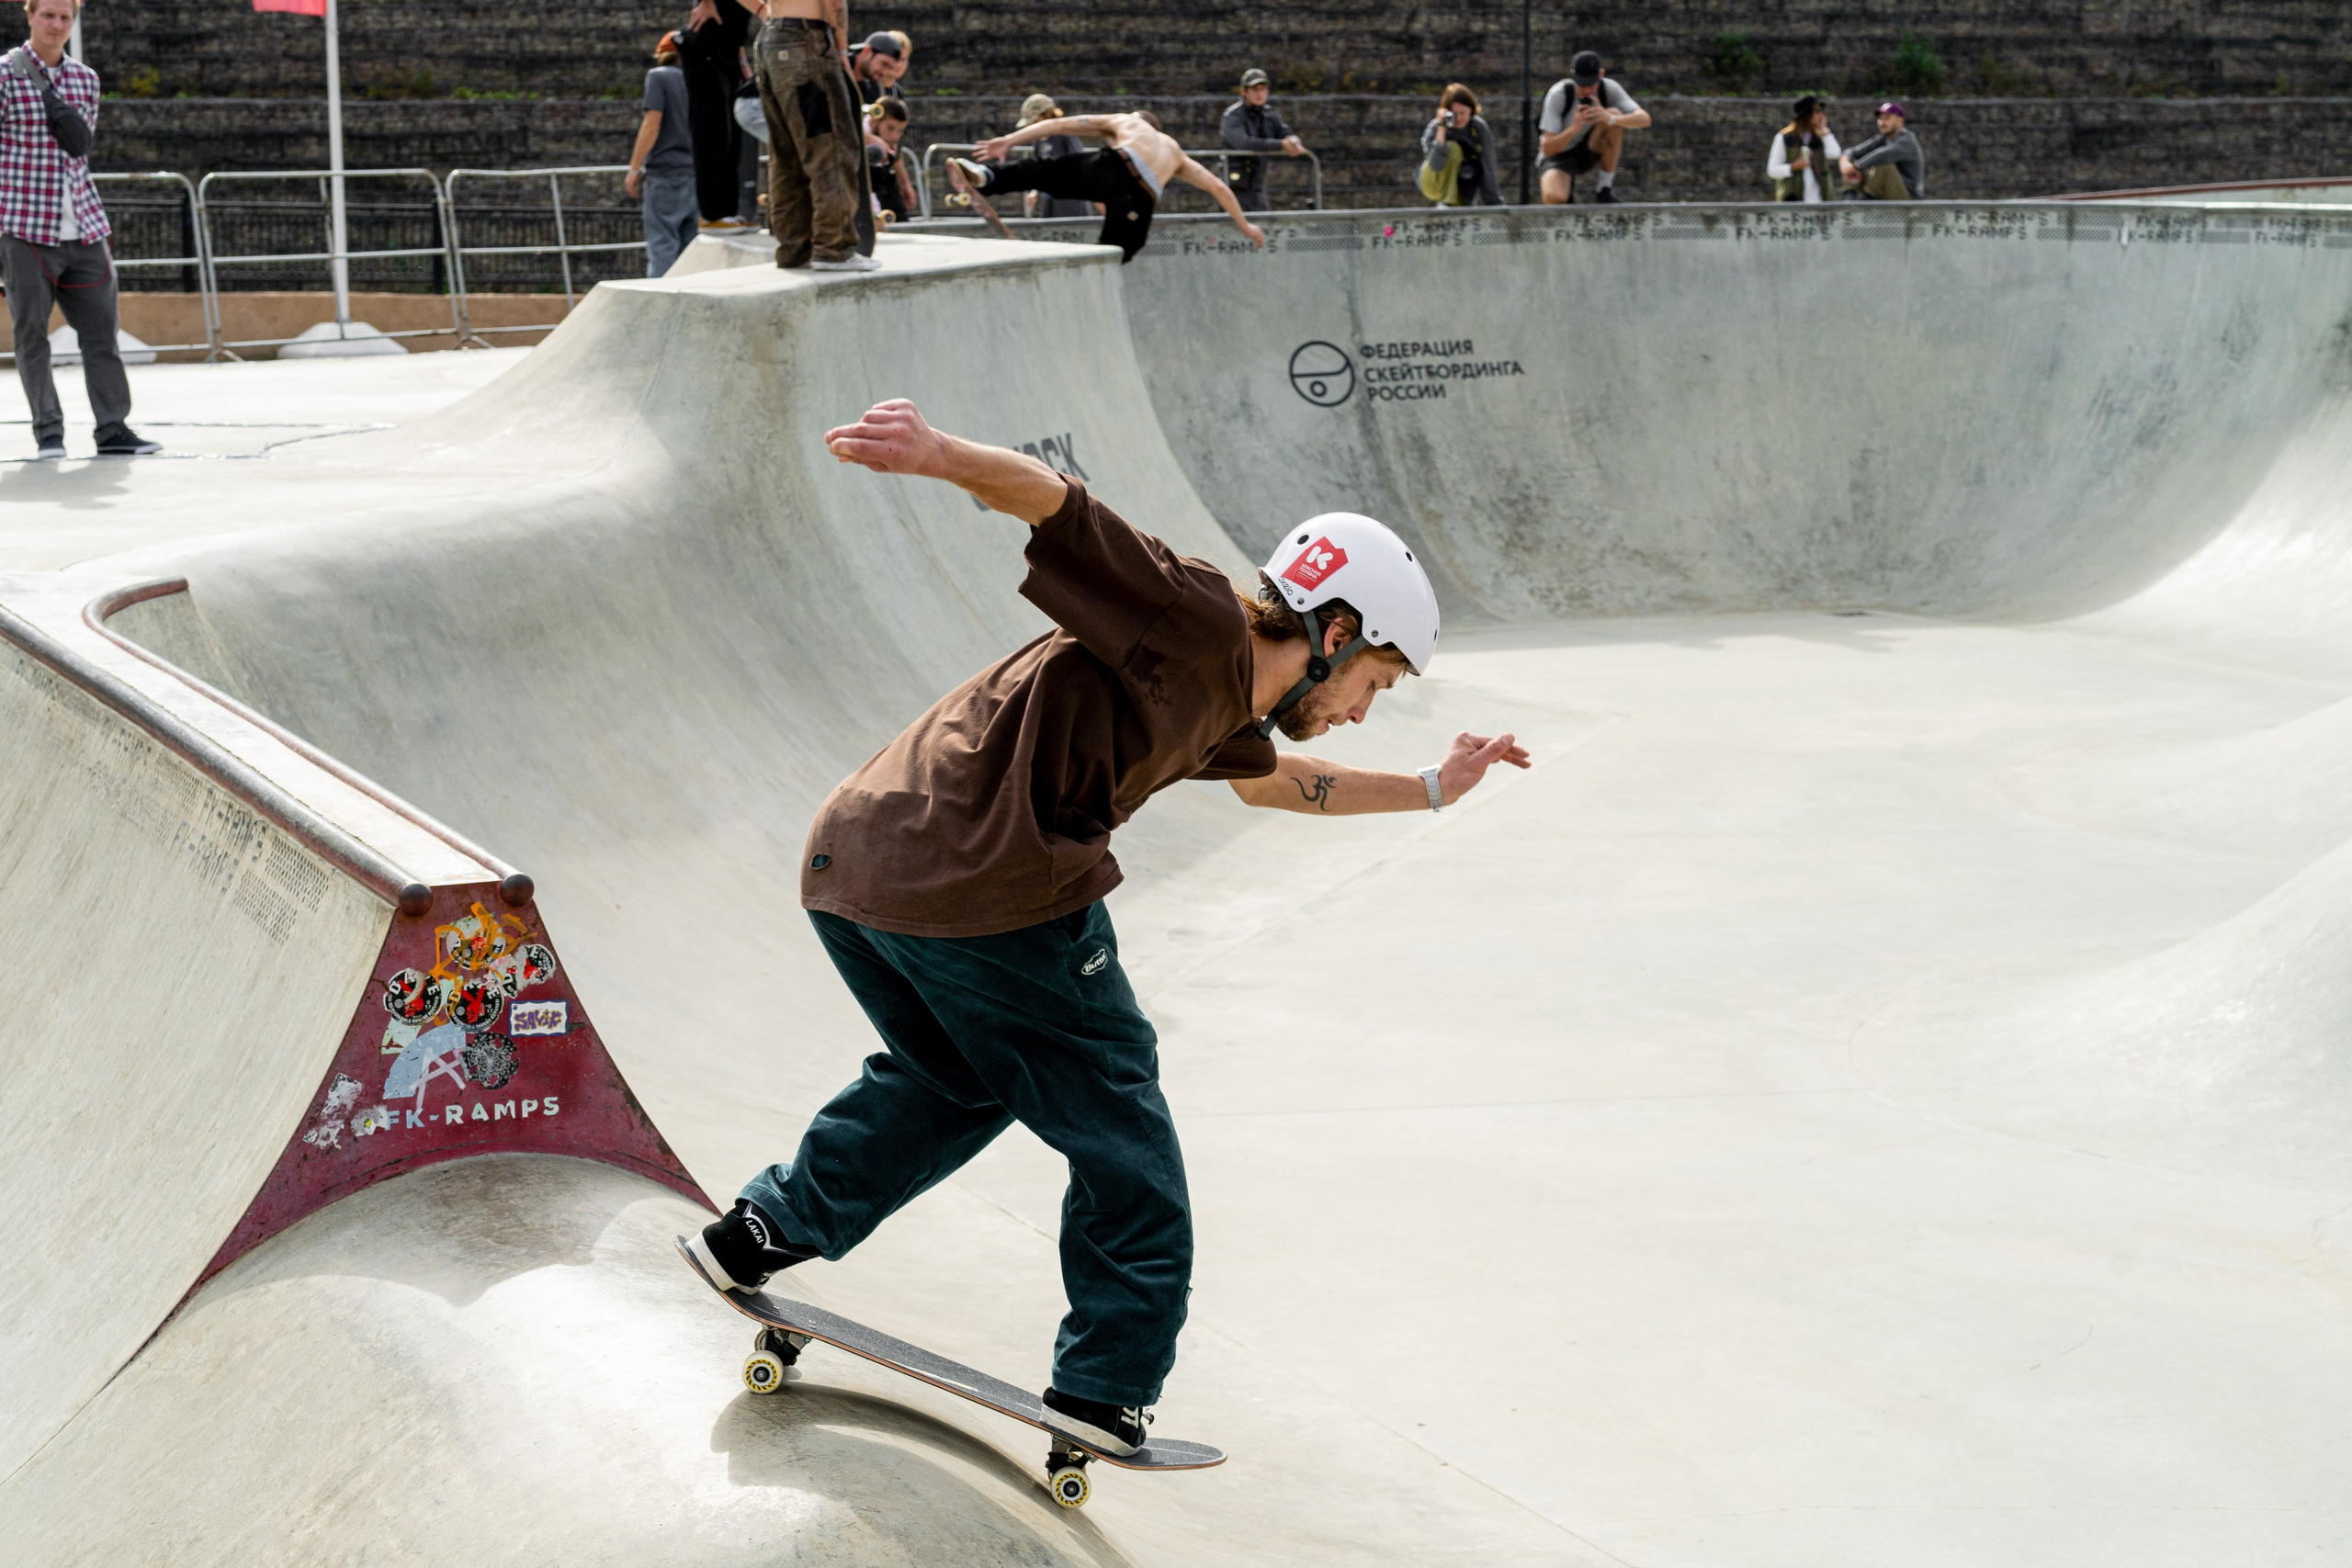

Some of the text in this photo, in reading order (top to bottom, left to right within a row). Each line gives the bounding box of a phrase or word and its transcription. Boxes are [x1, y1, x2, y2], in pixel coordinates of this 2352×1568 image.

[1183, 239, 1278, 254] FK-RAMS
[1360, 339, 1475, 359] ФЕДЕРАЦИЯ
[1364, 359, 1525, 383] СКЕЙТБОРДИНГА
[1368, 384, 1447, 401] РОССИИ
[383, 1097, 560, 1132] FK-RAMPS
[745, 1219, 764, 1244] LAKAI
